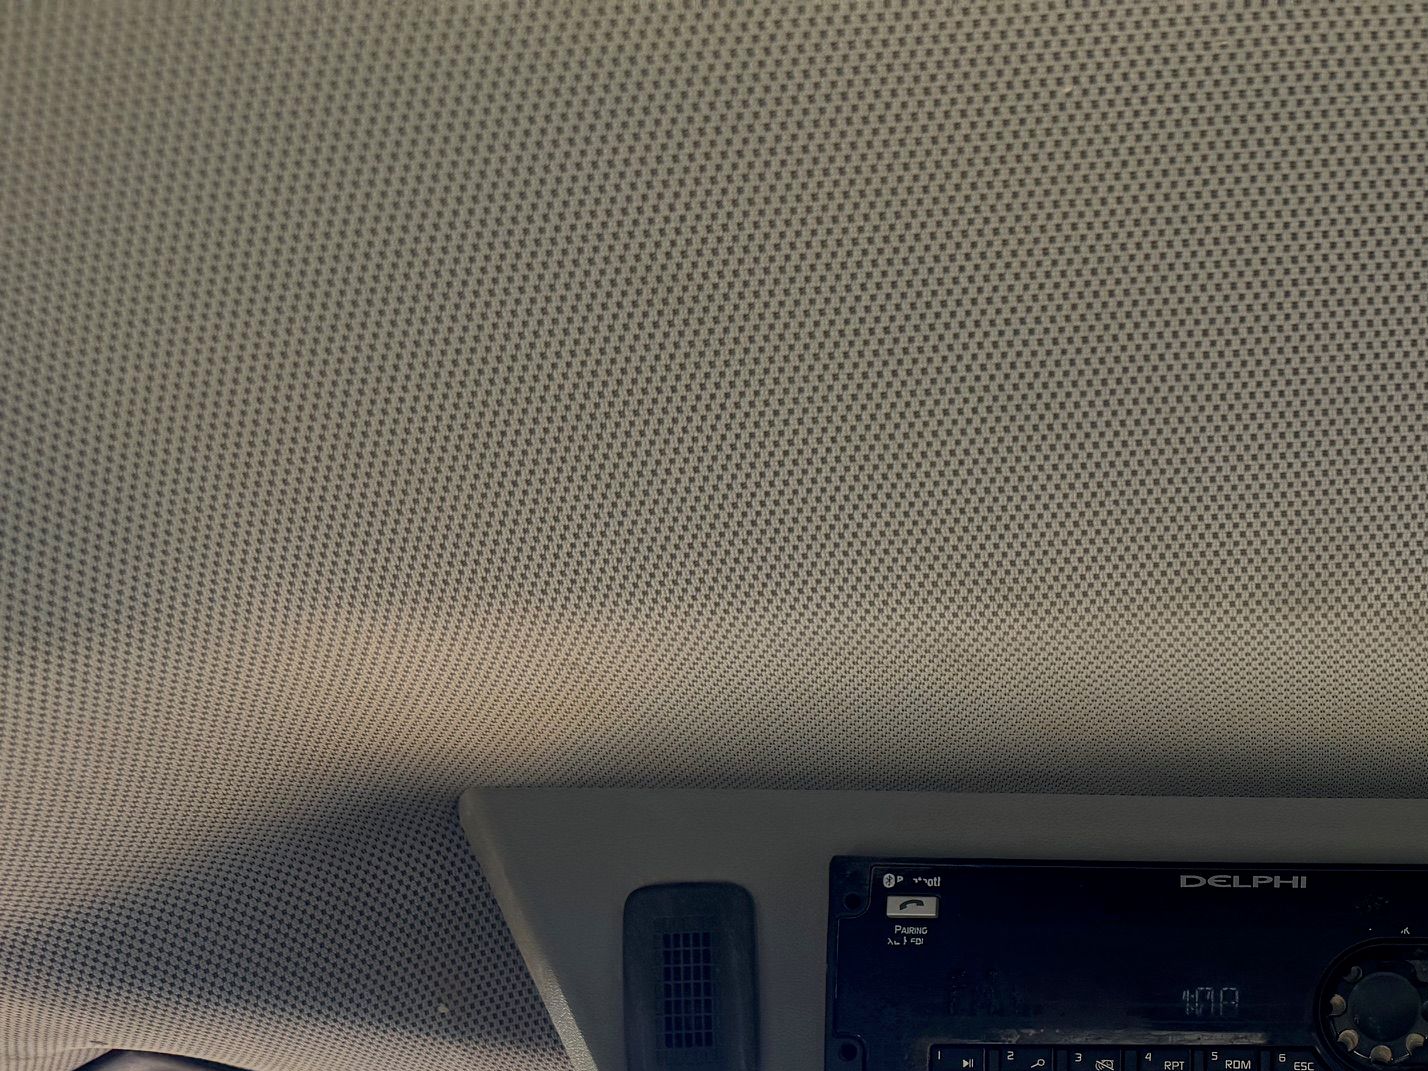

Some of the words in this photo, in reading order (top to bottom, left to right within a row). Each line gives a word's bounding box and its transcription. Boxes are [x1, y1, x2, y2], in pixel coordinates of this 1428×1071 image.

[1180, 875, 1307, 889] DELPHI
[1006, 1050, 1015, 1060] 2
[1074, 1052, 1083, 1062] 3
[1144, 1052, 1153, 1062] 4
[1164, 1060, 1186, 1071] RPT
[1210, 1051, 1219, 1061] 5
[1224, 1059, 1252, 1071] RDM
[1278, 1053, 1287, 1063] 6
[1293, 1061, 1316, 1071] ESC
